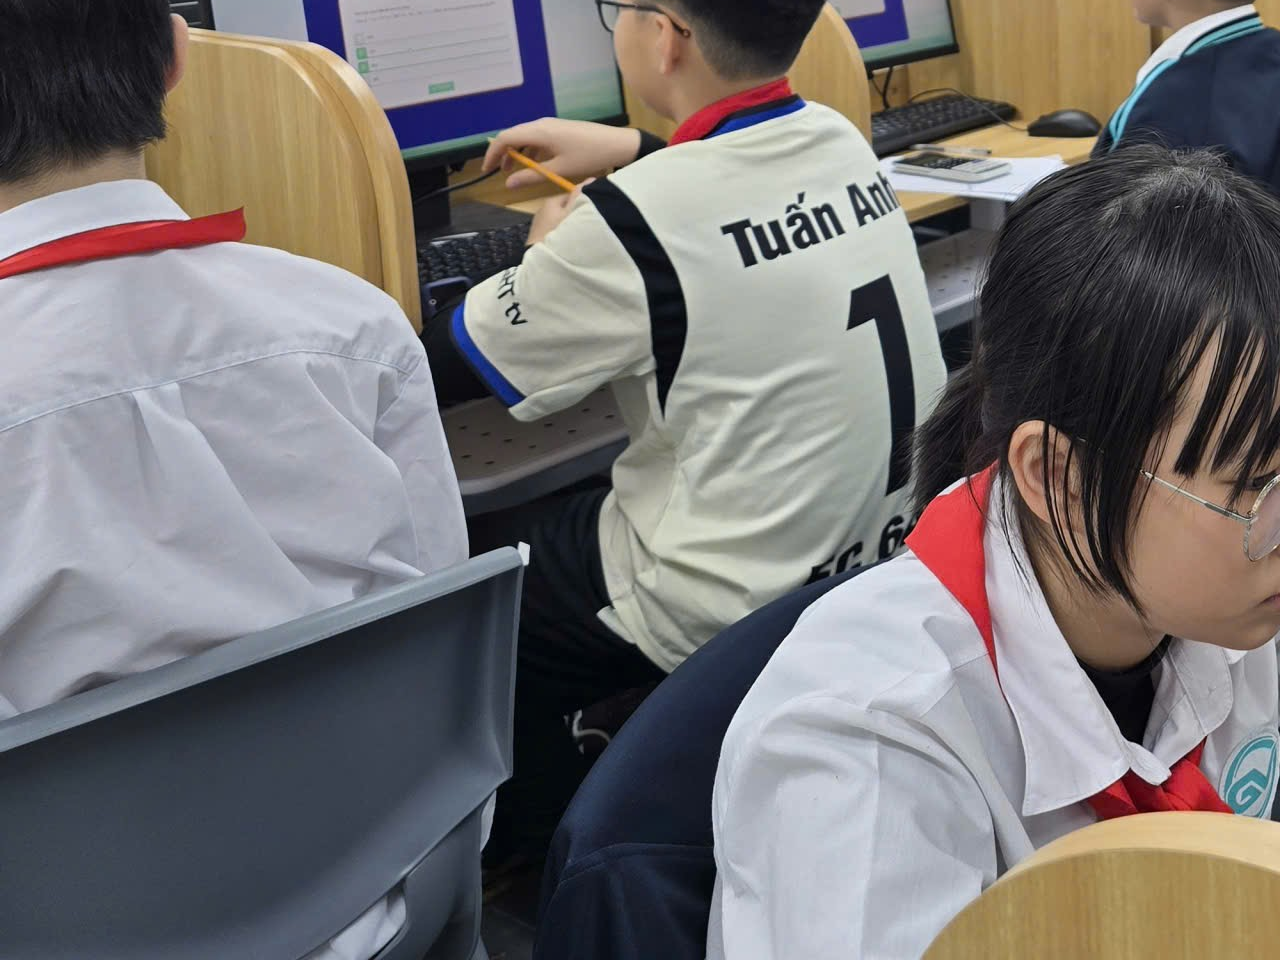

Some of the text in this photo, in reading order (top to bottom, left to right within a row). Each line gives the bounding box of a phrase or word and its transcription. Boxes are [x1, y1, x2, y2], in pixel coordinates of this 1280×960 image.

[720, 171, 901, 268] Tuấn Anh
[846, 273, 915, 496] 1
